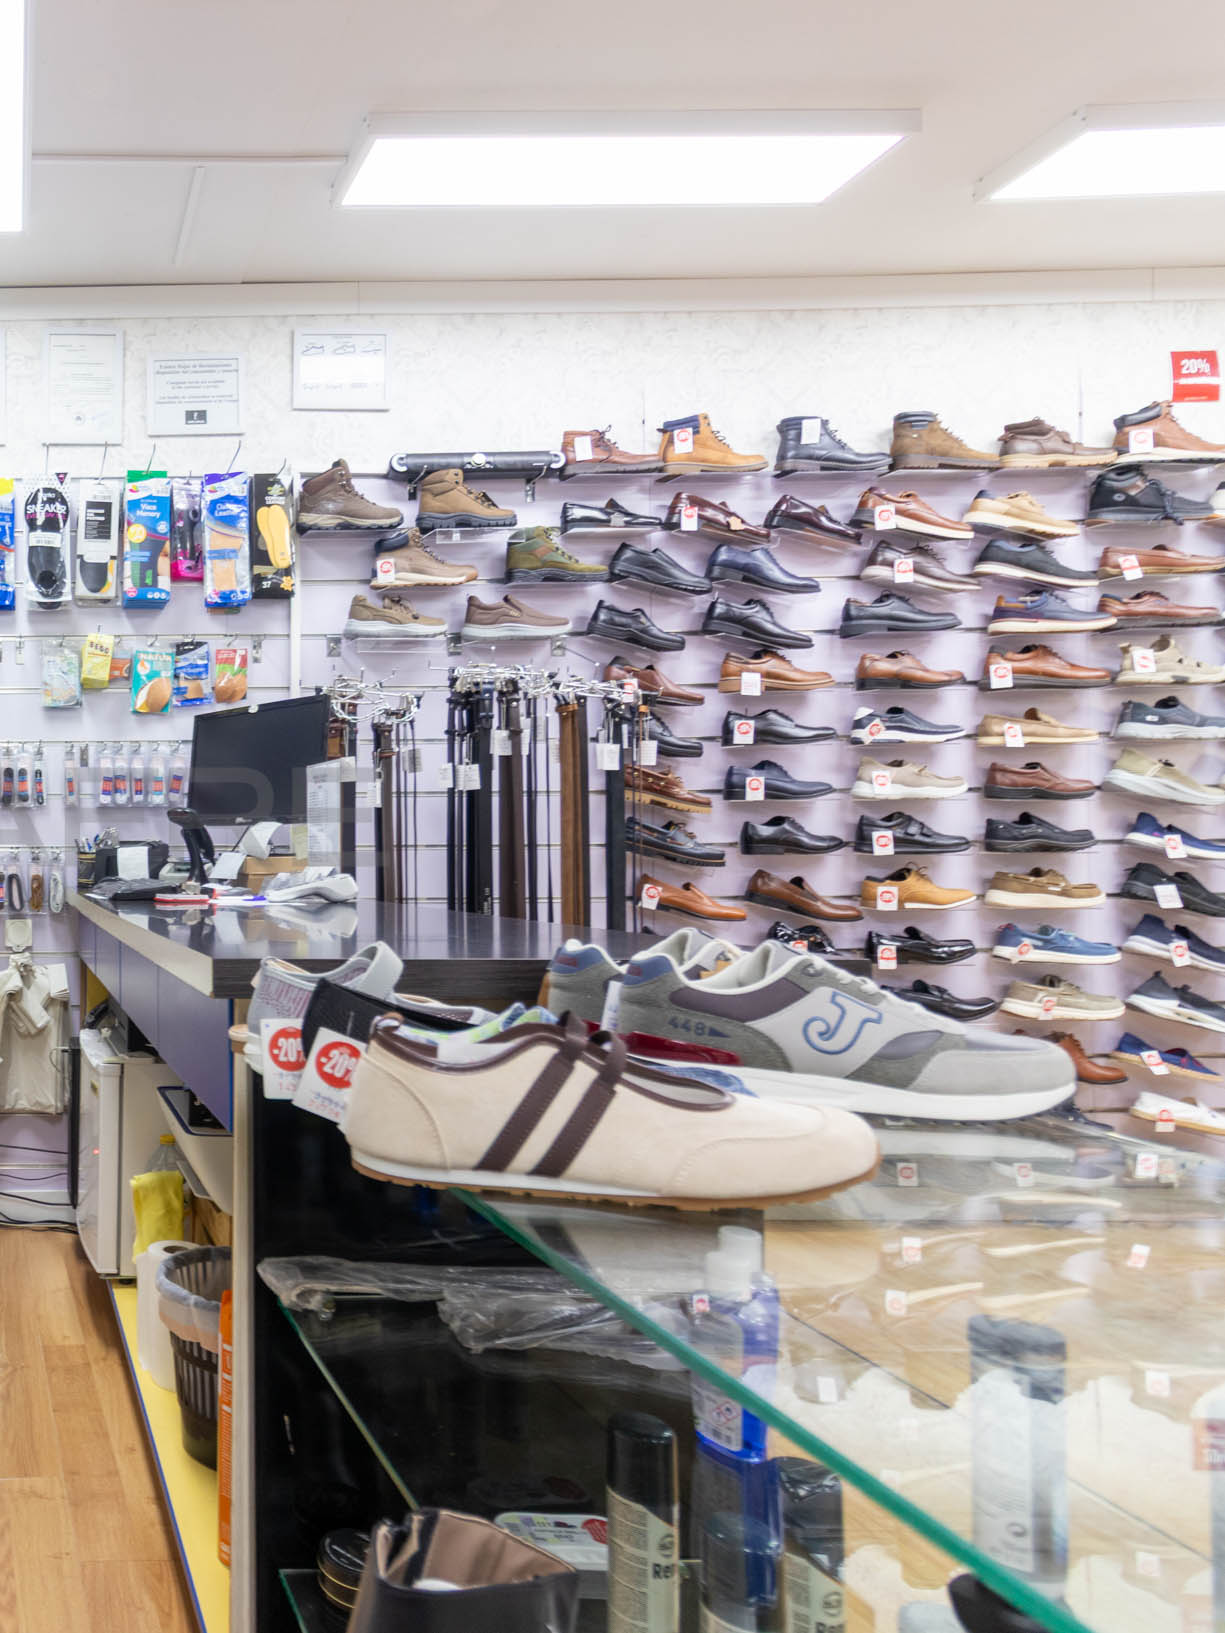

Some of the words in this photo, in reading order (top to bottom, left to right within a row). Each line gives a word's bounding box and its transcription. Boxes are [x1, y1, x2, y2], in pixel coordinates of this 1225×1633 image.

[1180, 358, 1210, 375] 20%
[262, 580, 273, 589] 37
[668, 1015, 706, 1037] 448
